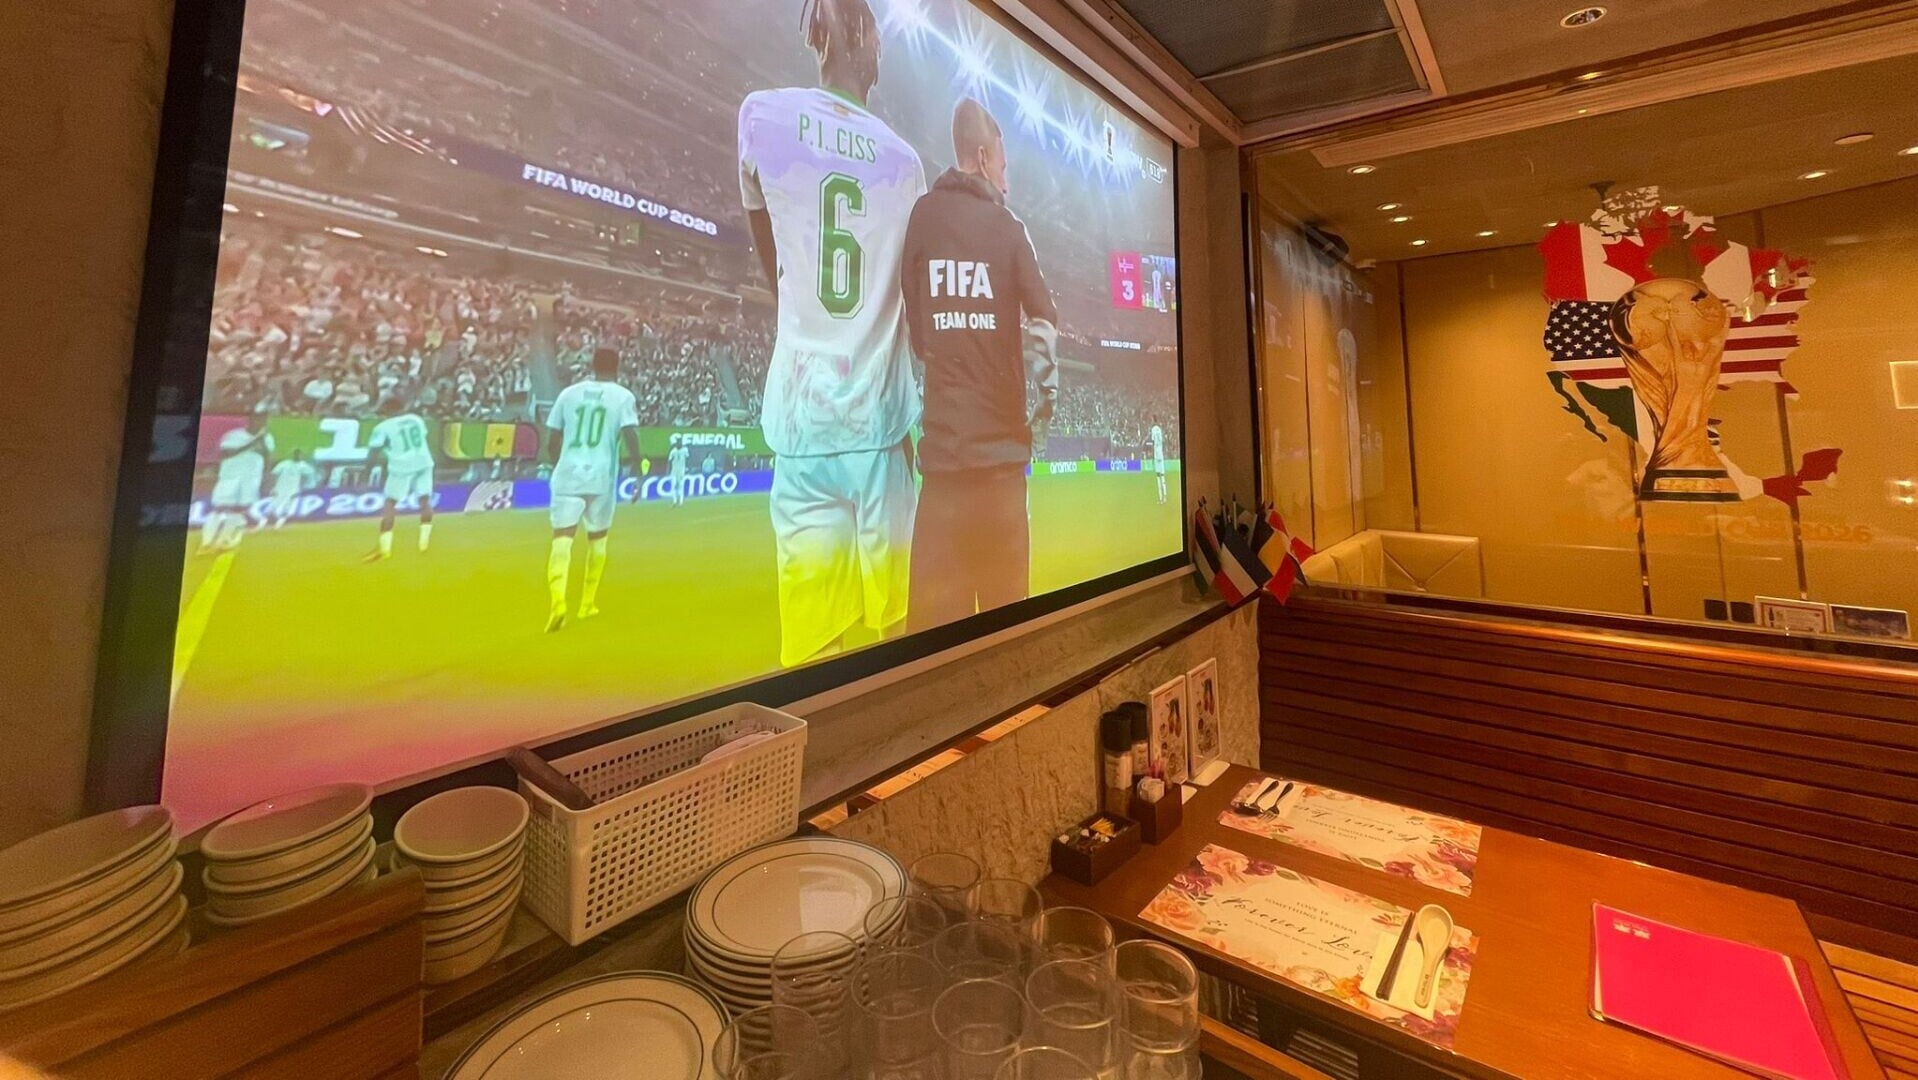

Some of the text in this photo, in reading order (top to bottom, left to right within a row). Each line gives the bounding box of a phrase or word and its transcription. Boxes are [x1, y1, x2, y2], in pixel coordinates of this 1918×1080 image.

[799, 113, 876, 164] P.I. CISS
[522, 163, 718, 236] FIFA WORLD CUP 2026
[817, 171, 866, 319] 6
[929, 259, 994, 300] FIFA
[1121, 279, 1135, 301] 3
[933, 311, 996, 330] TEAM ONE
[314, 418, 370, 462] 1
[569, 404, 607, 449] 10
[619, 472, 738, 499] aramco
[1221, 897, 1315, 935] Forever
[1321, 934, 1373, 960] Lov
